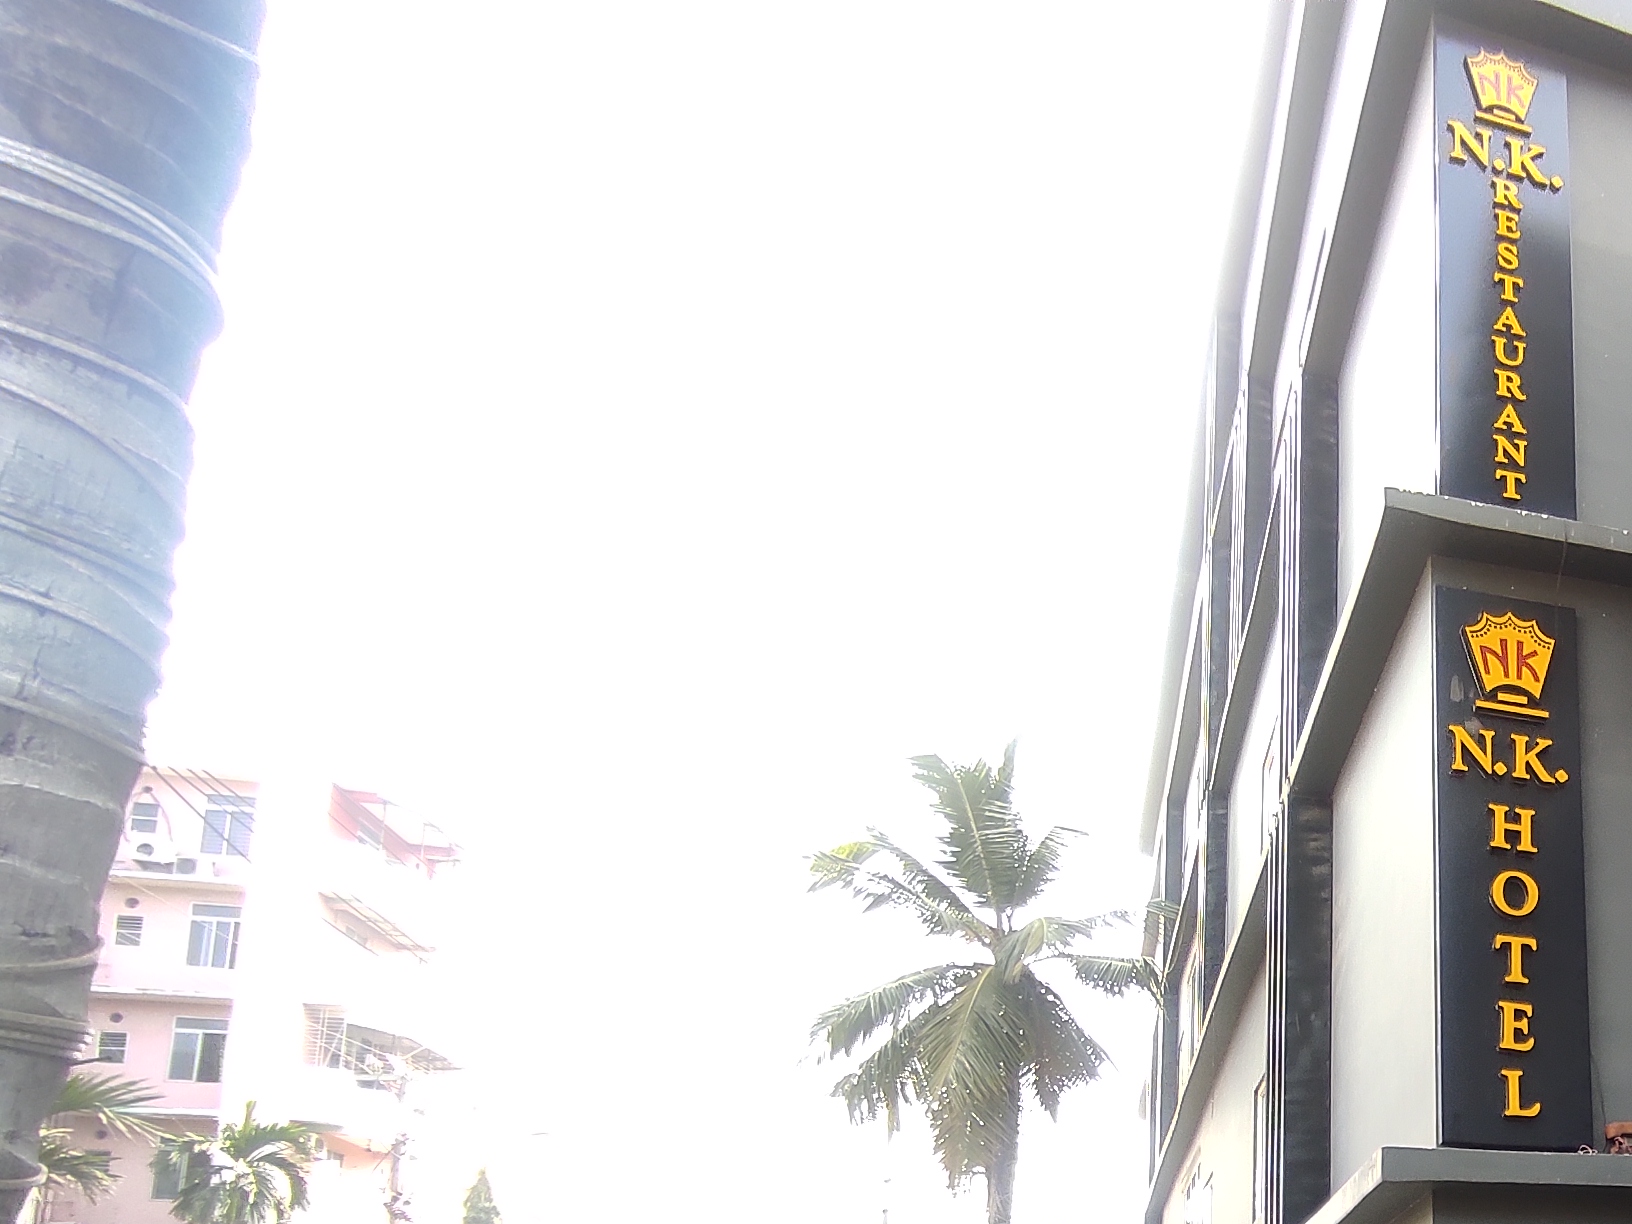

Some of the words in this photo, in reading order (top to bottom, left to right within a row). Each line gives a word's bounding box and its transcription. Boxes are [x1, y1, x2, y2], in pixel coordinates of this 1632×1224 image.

[1477, 70, 1526, 110] NK
[1447, 119, 1564, 191] N.K.
[1492, 177, 1527, 500] RESTAURANT
[1480, 638, 1540, 683] NK
[1448, 724, 1569, 784] N.K.
[1489, 803, 1541, 1117] HOTEL
